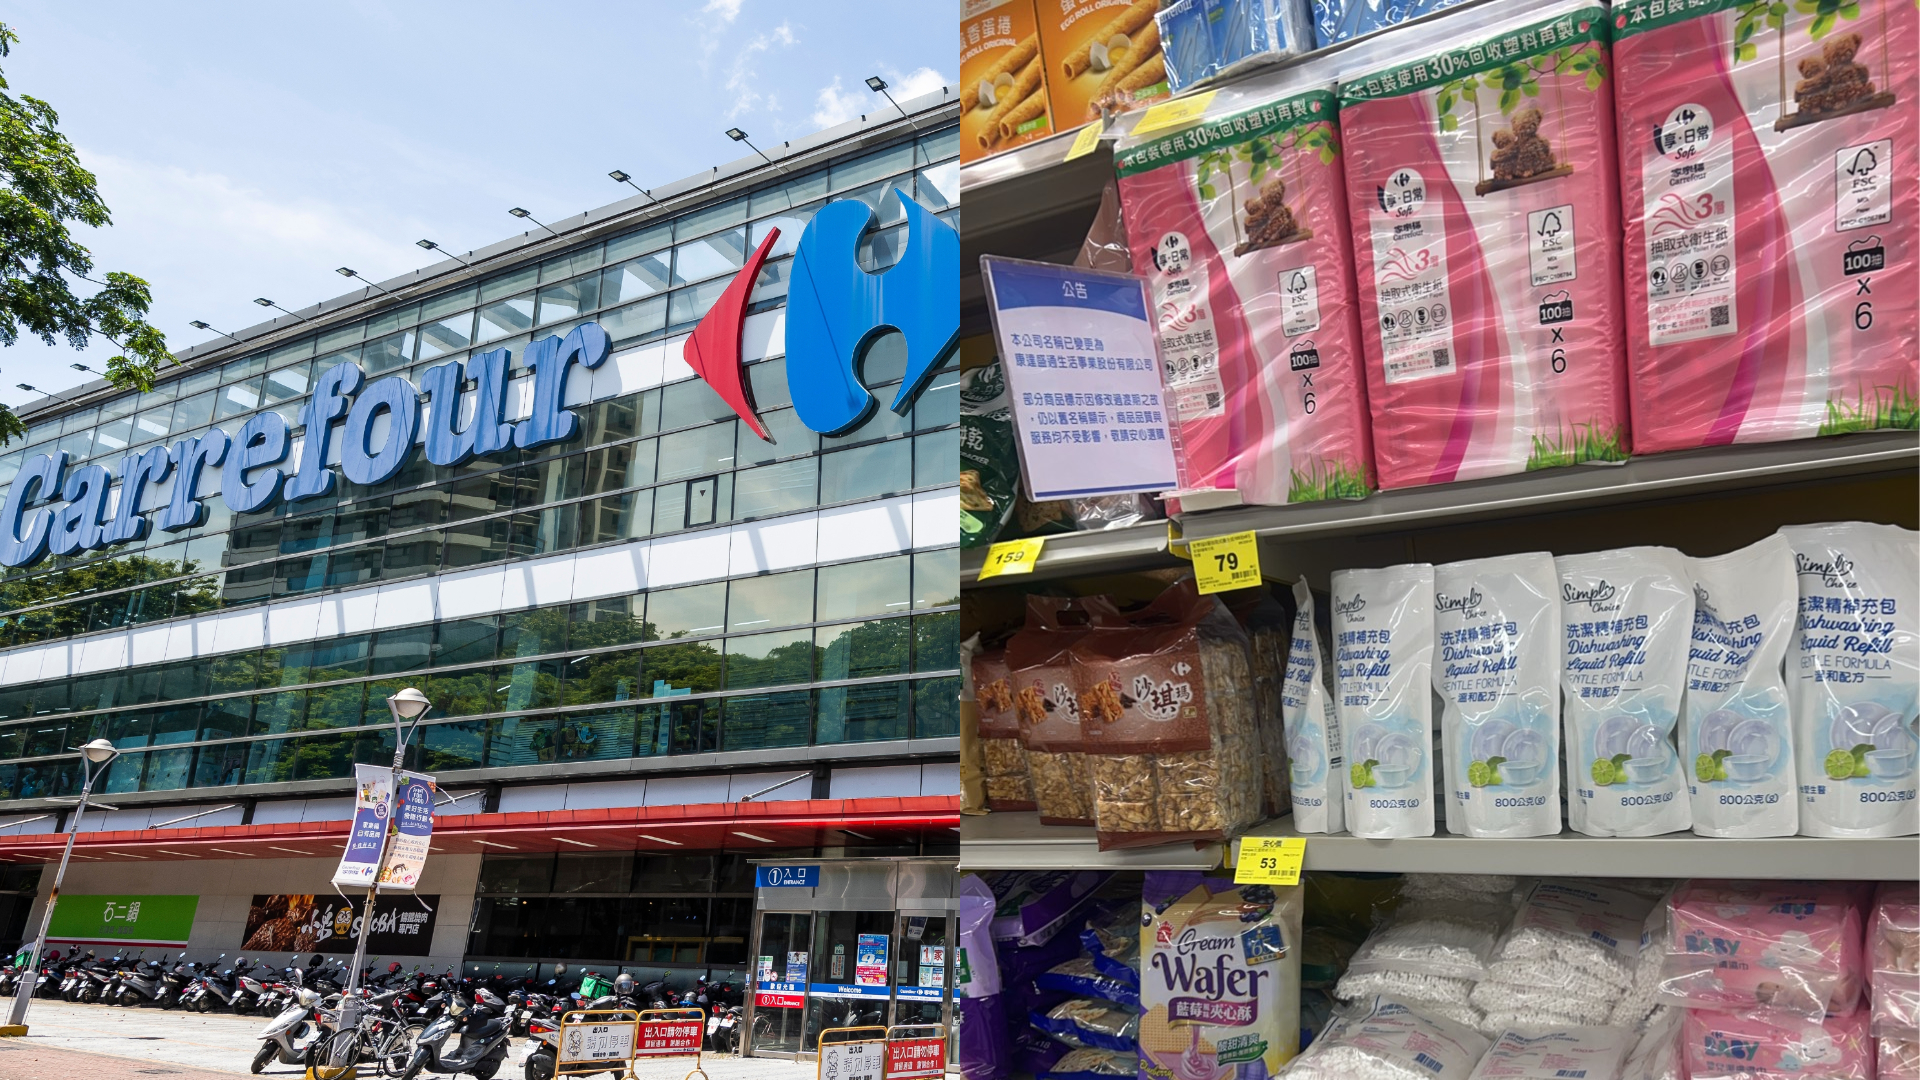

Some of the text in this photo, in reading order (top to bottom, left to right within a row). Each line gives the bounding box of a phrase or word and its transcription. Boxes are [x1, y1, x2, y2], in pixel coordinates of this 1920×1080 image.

[1075, 6, 1095, 20] ROLL
[966, 45, 984, 60] ROLL
[1675, 145, 1697, 160] Soft
[1669, 172, 1706, 186] Carrefour
[1853, 175, 1877, 189] FSC
[1396, 205, 1413, 218] Soft
[1393, 229, 1424, 241] Carrefour
[1542, 237, 1563, 248] FSC
[1651, 227, 1728, 255] 抽取式衛生紙
[1168, 263, 1182, 276] Soft
[1062, 280, 1088, 300] 公告
[1292, 293, 1308, 304] FSC
[1855, 302, 1873, 330] 6
[1011, 333, 1104, 351] 本公司名稱已變更為
[1015, 353, 1153, 372] 康達盛通生活事業股份有限公司
[1551, 348, 1567, 374] 6
[1023, 392, 1160, 406] 部分商品標示因修改過渡期之故
[1304, 392, 1316, 414] 6
[0, 321, 612, 567] Carrefour
[996, 551, 1024, 564] 159
[1214, 552, 1238, 572] 79
[1592, 602, 1621, 613] Choice
[1566, 615, 1648, 639] 洗潔精補充包
[1568, 634, 1648, 656] Dishwashing
[1843, 636, 1894, 657] Refill
[1566, 650, 1647, 673] Liquid Refill
[1835, 656, 1891, 670] FORMULA
[1356, 663, 1391, 680] Refill
[1445, 661, 1480, 679] Liquid
[1134, 676, 1192, 713] 沙琪瑪
[405, 804, 429, 815] 美好生活
[1260, 857, 1277, 869] 53
[784, 868, 806, 878] 入口
[103, 901, 141, 923] 石二鍋
[1177, 928, 1236, 956] Cream
[1685, 935, 1741, 956] BABY
[860, 953, 875, 966] 9
[1152, 952, 1269, 1001] Wafer
[838, 985, 862, 995] Welcome
[770, 995, 784, 1006] 入口
[592, 1026, 609, 1034] 出入口
[644, 1025, 699, 1039] 出入口請勿停車
[586, 1034, 630, 1053] 請勿停車
[1217, 1033, 1260, 1051] 酸甜清爽
[1704, 1036, 1760, 1062] BABY
[848, 1046, 863, 1055] 出入口
[892, 1044, 940, 1060] 出入口請勿停車
